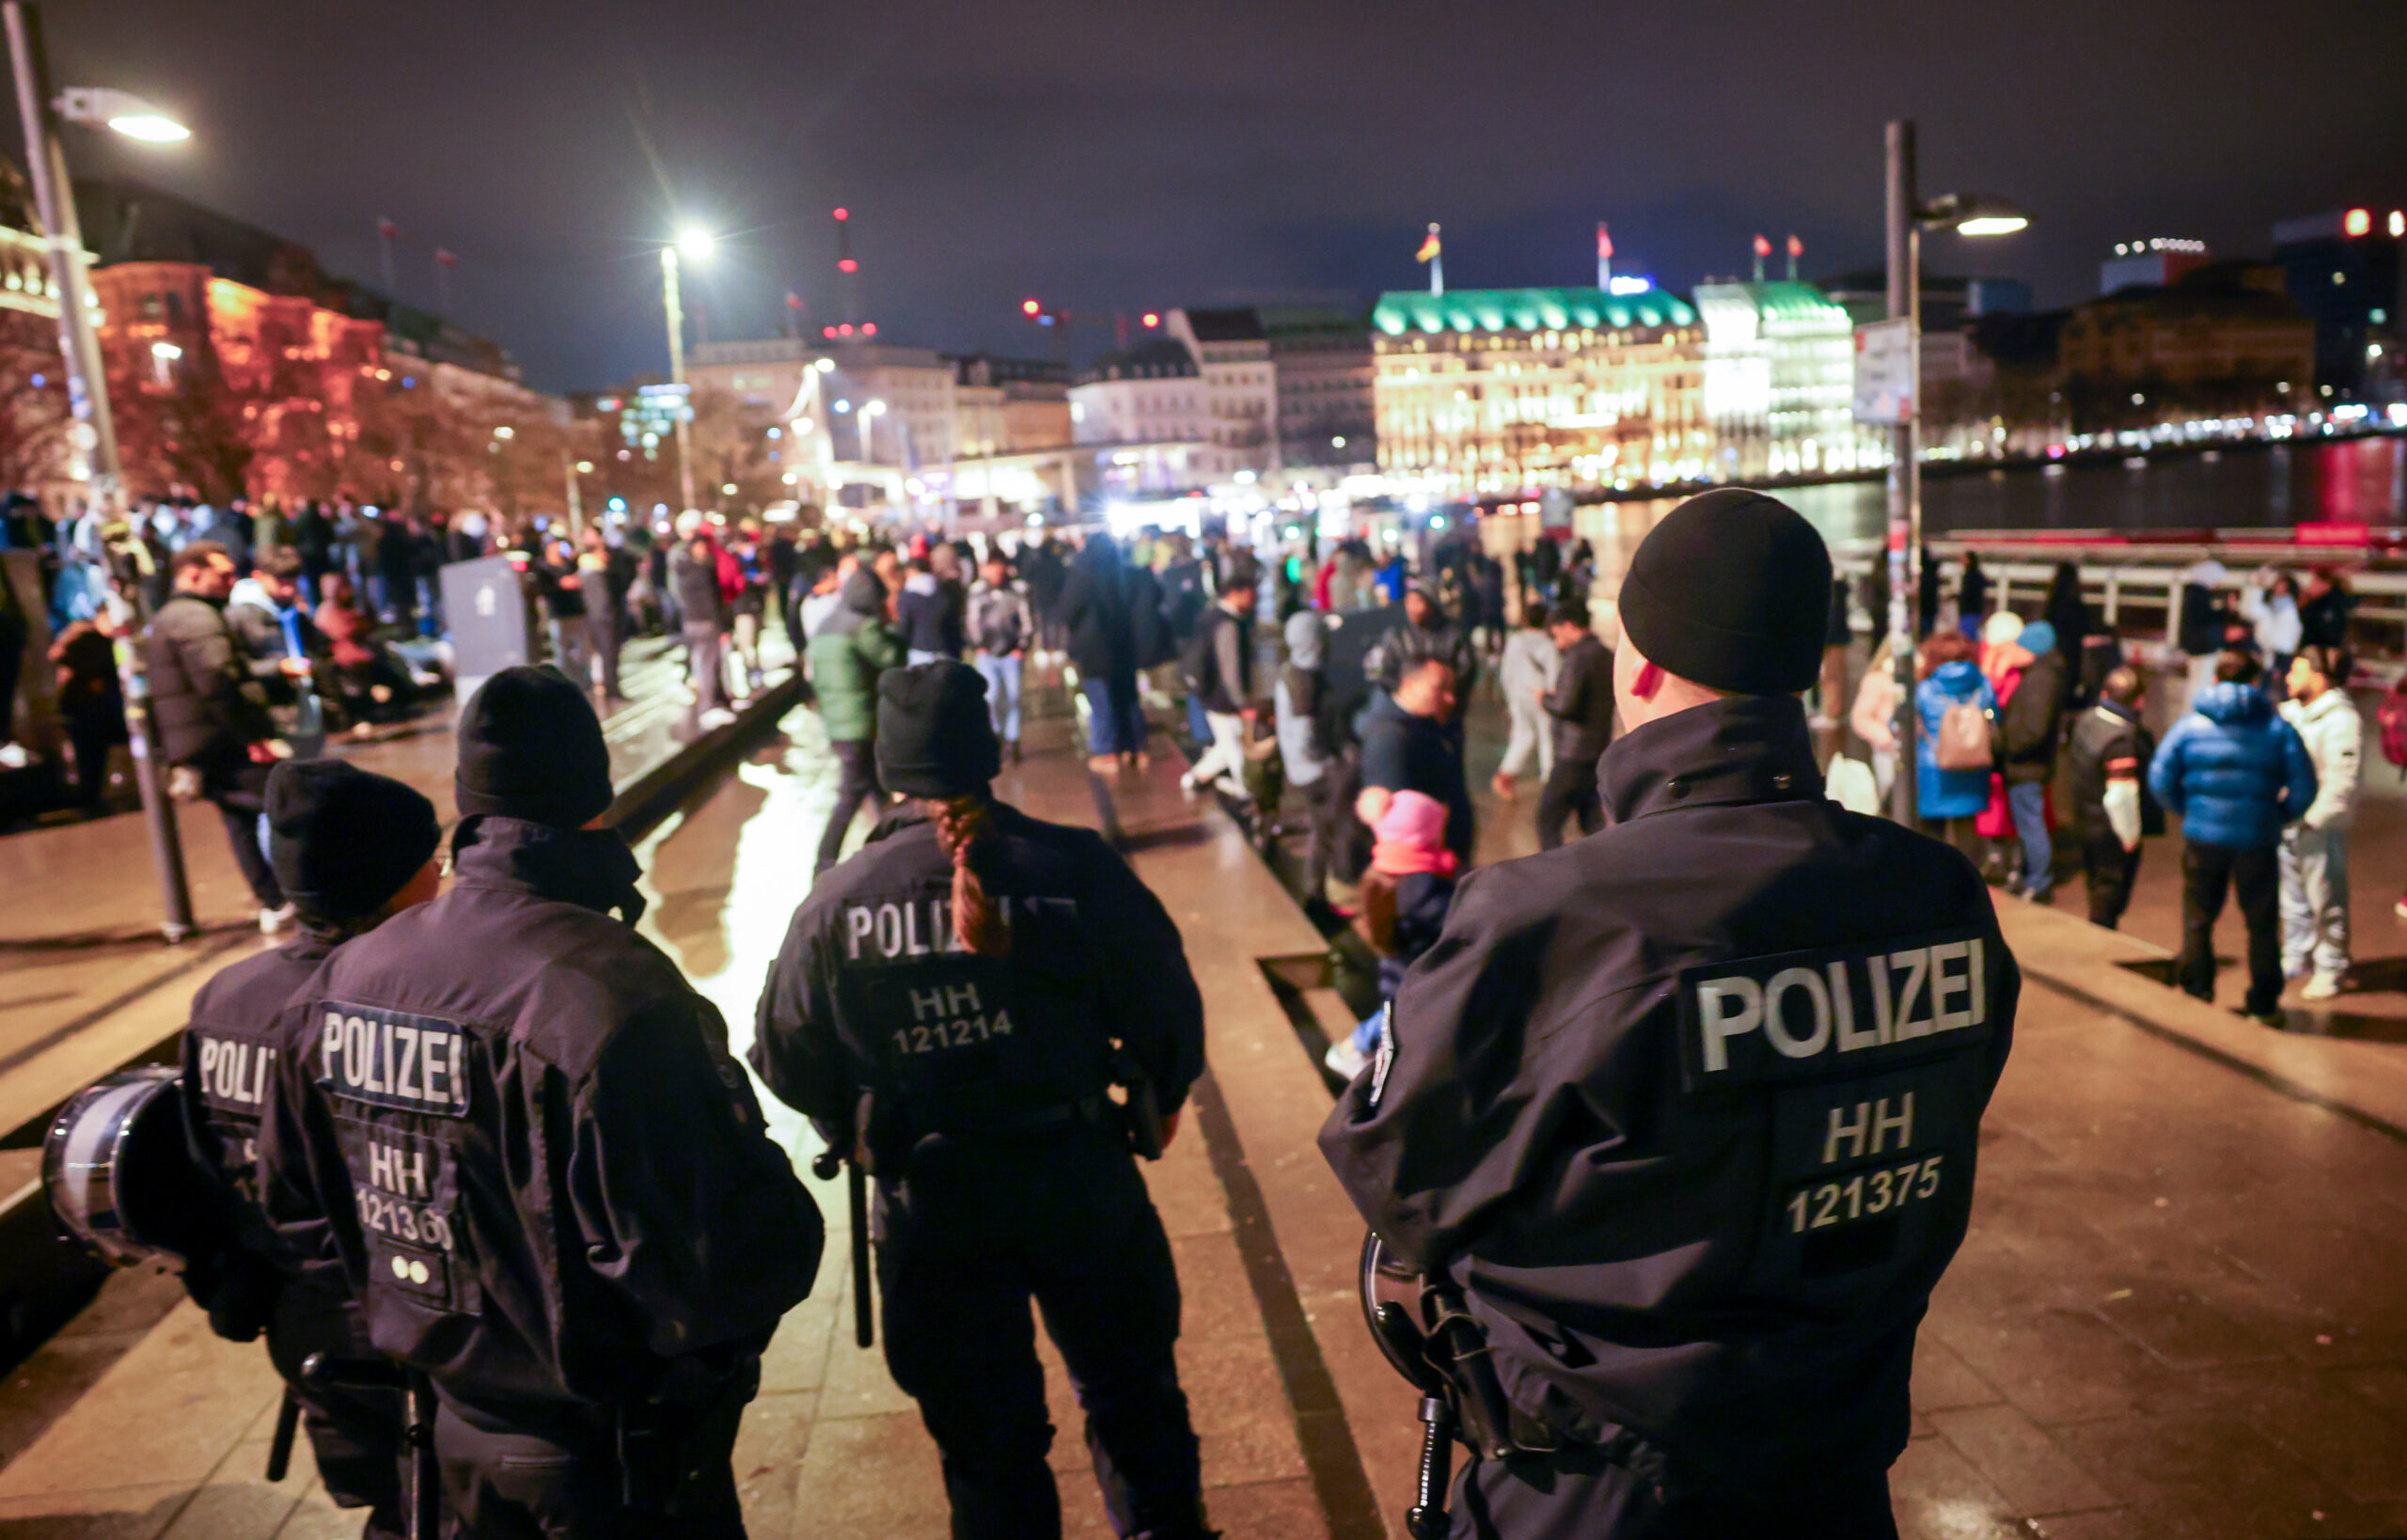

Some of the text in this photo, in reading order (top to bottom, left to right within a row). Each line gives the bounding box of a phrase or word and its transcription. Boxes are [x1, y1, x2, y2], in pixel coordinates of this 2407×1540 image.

[848, 895, 1037, 959] POLI
[893, 1009, 1014, 1054] 121214
[909, 982, 983, 1021] HH
[1696, 938, 1986, 1073] POLIZEI
[199, 1036, 276, 1105] POLI
[322, 1012, 464, 1106] POLIZEI
[1822, 1091, 1914, 1164] HH
[368, 1140, 429, 1197] HH
[1786, 1155, 1943, 1234] 121375
